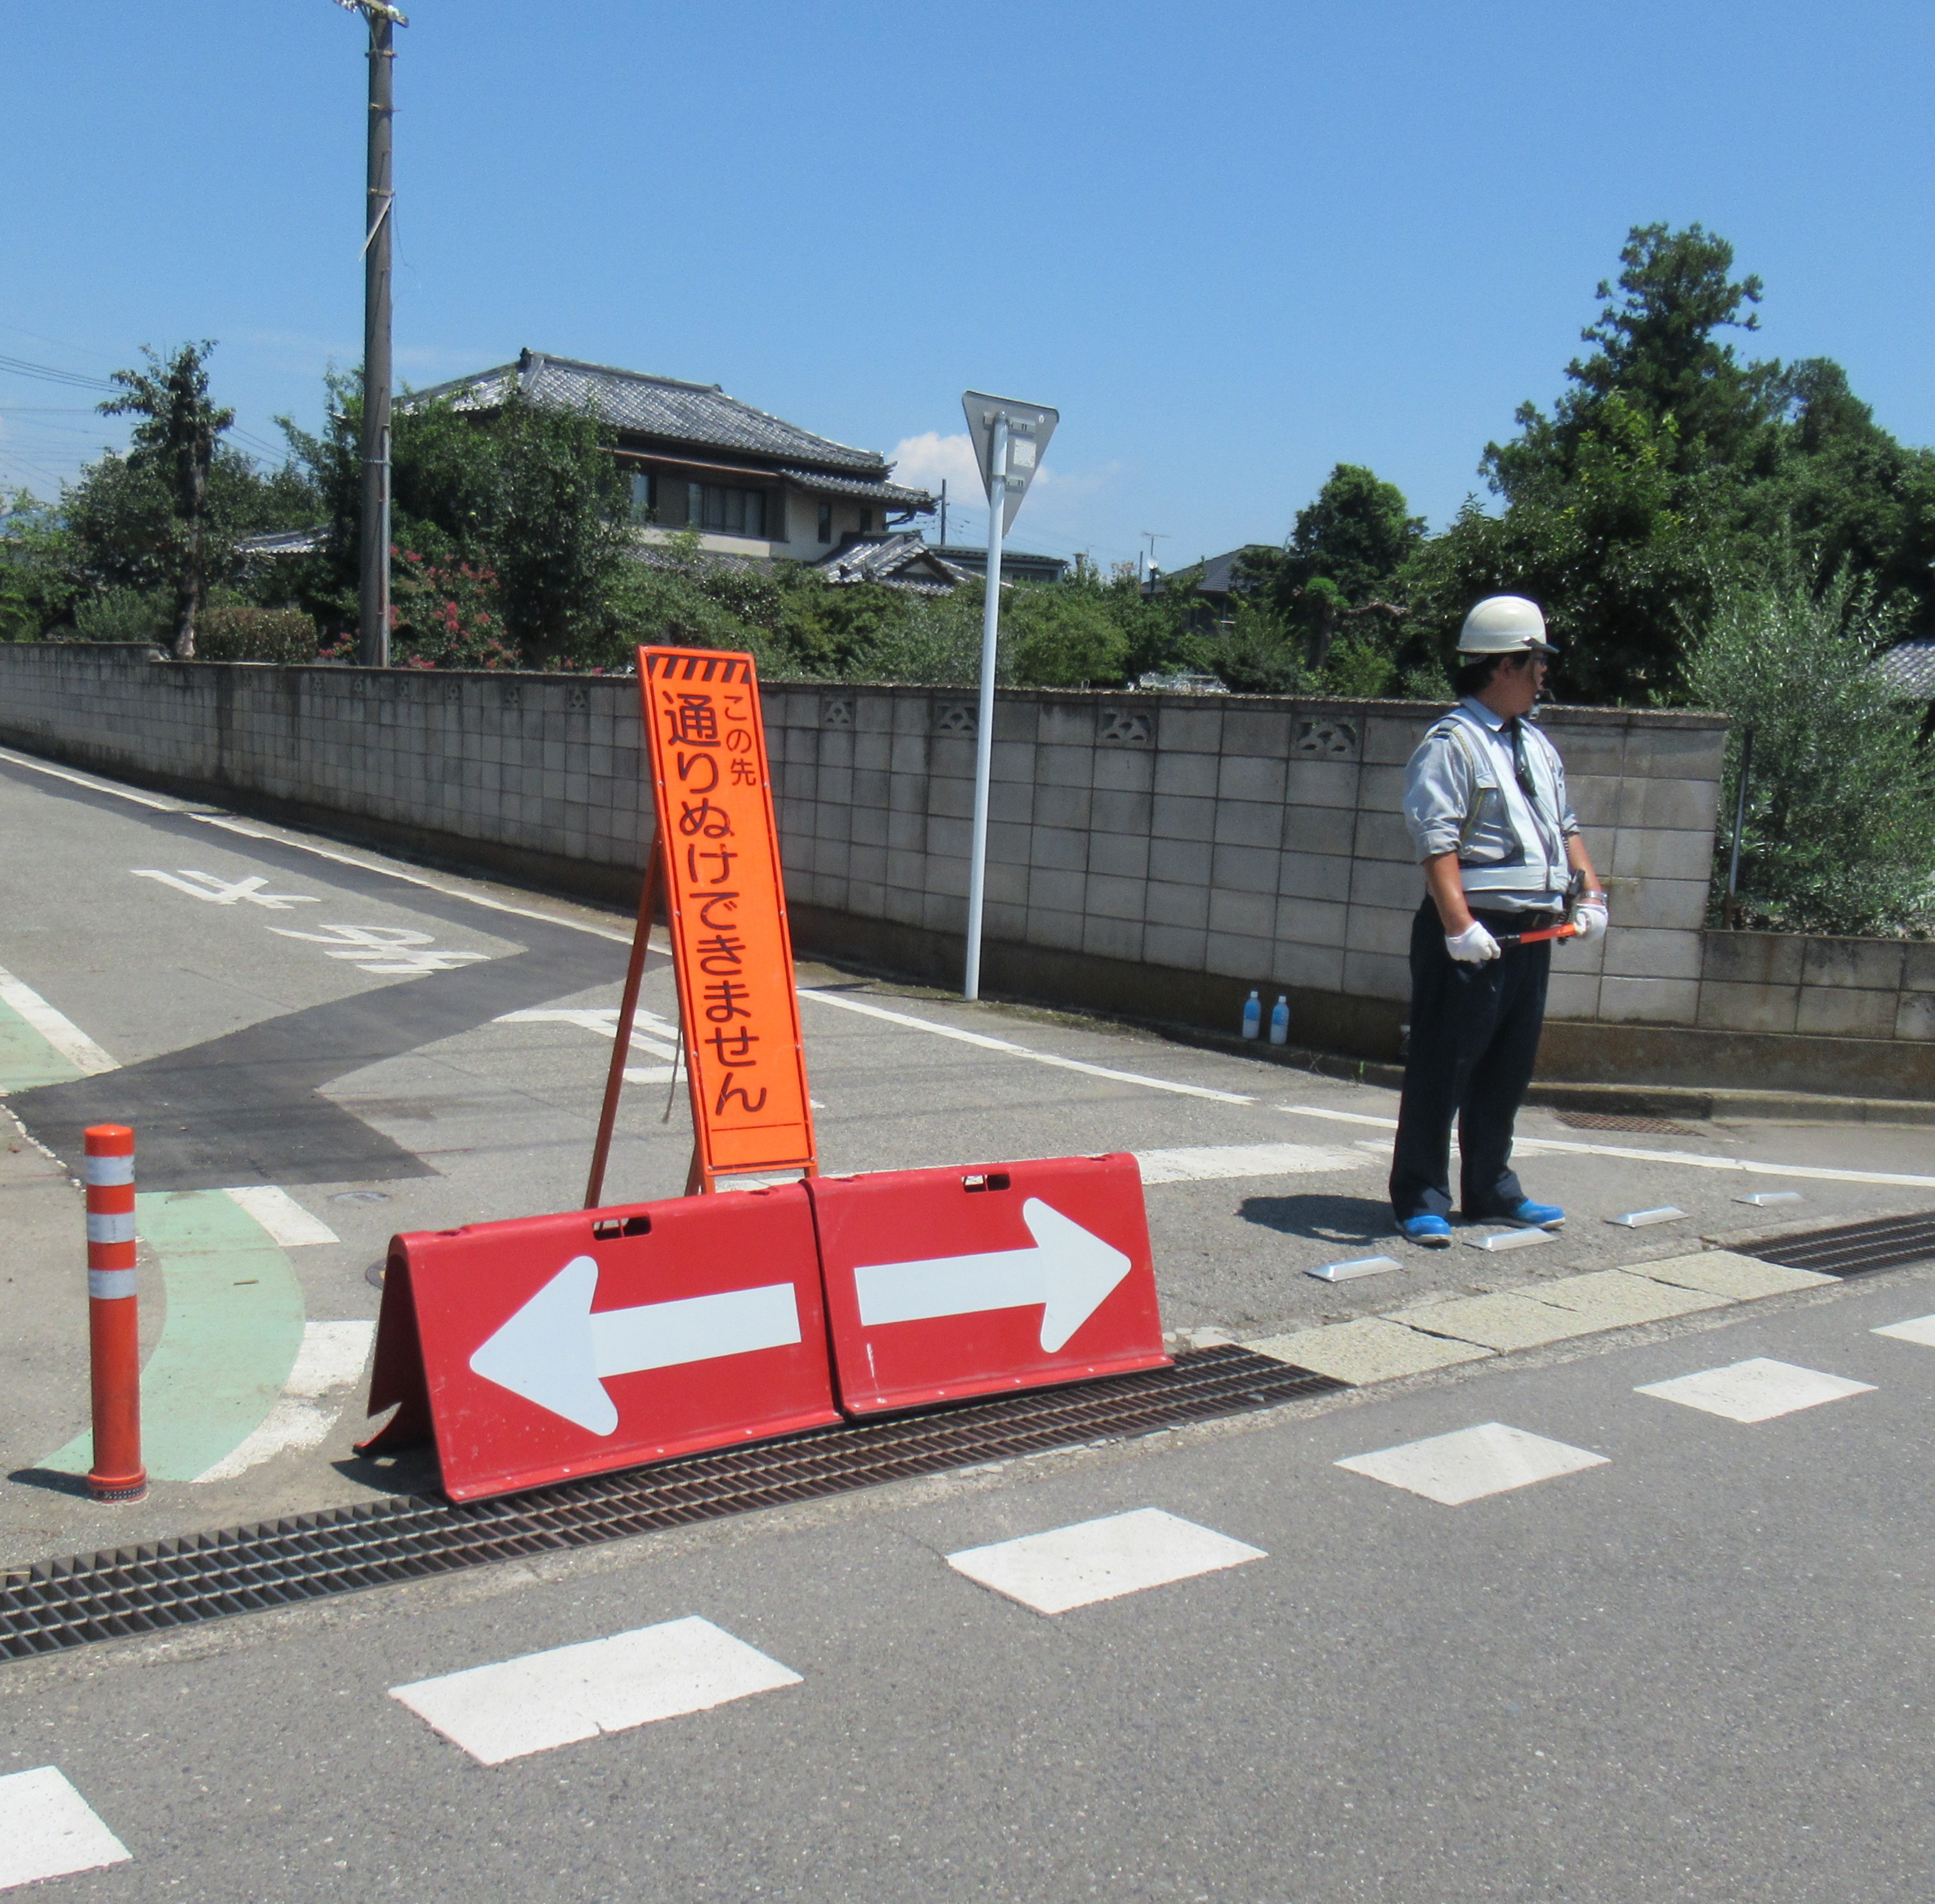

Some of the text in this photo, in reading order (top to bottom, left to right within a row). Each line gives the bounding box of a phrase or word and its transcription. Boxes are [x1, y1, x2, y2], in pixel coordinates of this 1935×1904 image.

[724, 695, 756, 786] この先
[662, 690, 767, 1116] 通りぬけできません
